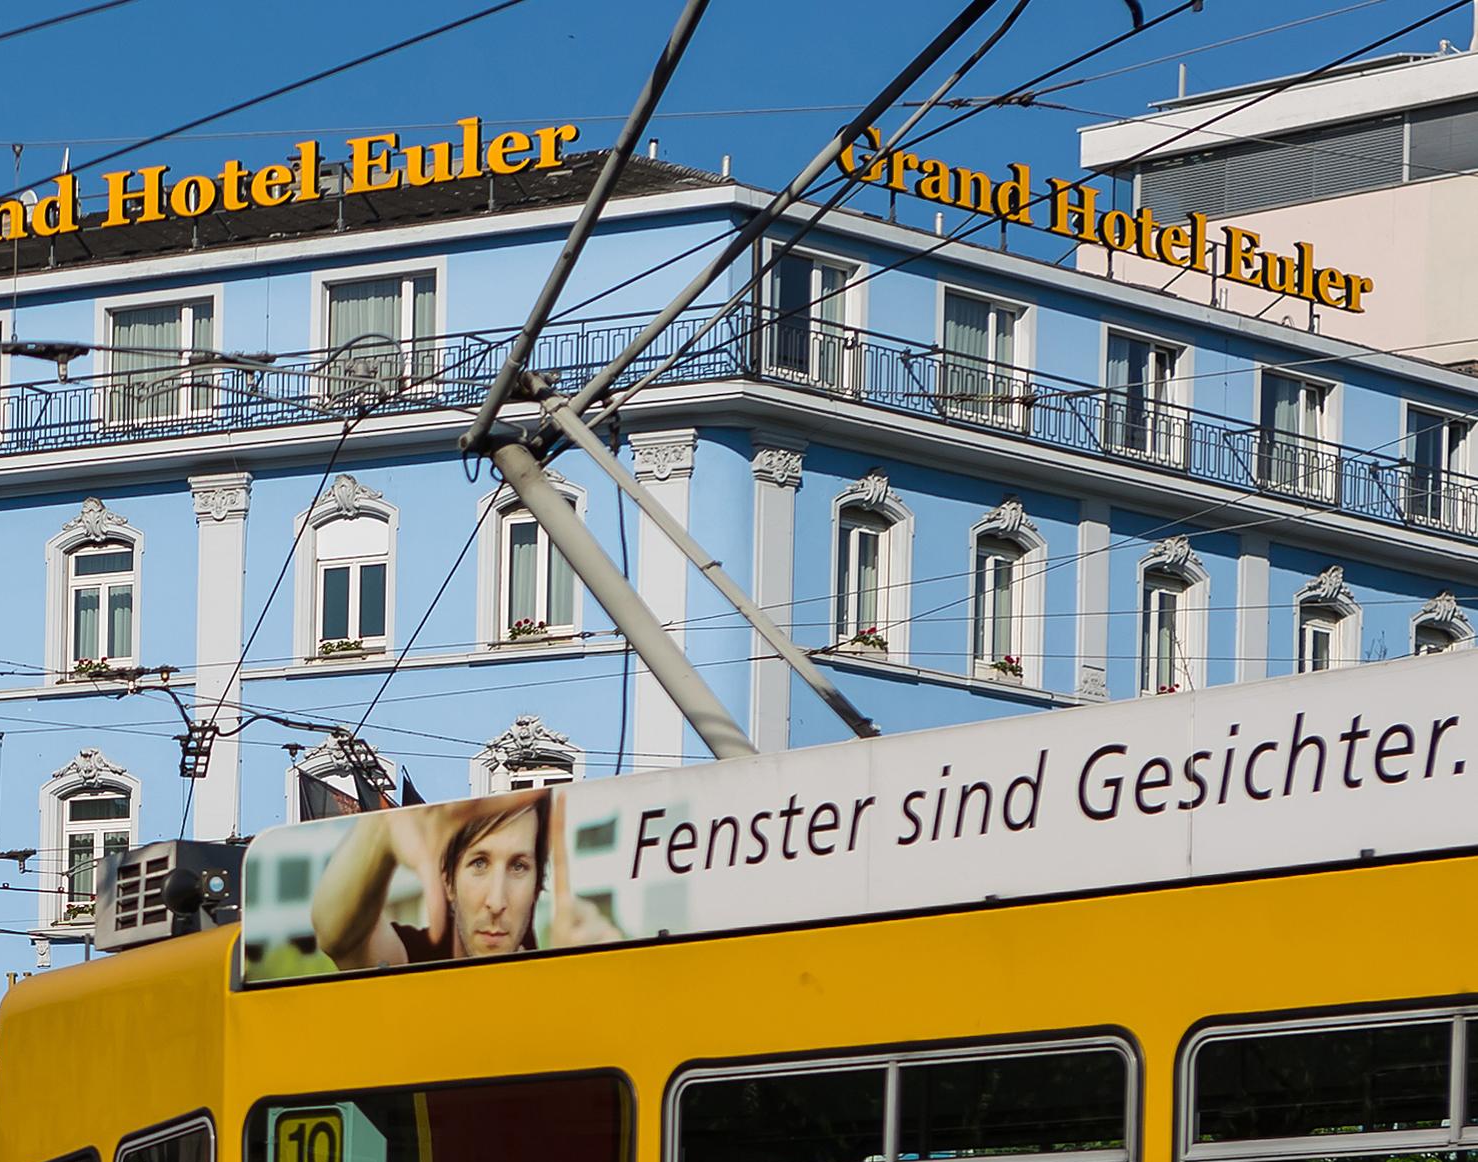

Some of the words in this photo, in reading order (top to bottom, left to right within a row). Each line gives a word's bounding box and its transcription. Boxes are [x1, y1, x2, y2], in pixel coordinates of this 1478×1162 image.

[101, 140, 322, 228] Hotel
[345, 116, 580, 195] Euler
[835, 124, 1034, 225] Grand
[1045, 177, 1209, 272] Hotel
[1221, 225, 1374, 314] Euler
[630, 793, 876, 880] Fenster
[897, 748, 1049, 846] sind
[1077, 711, 1467, 822] Gesichter.
